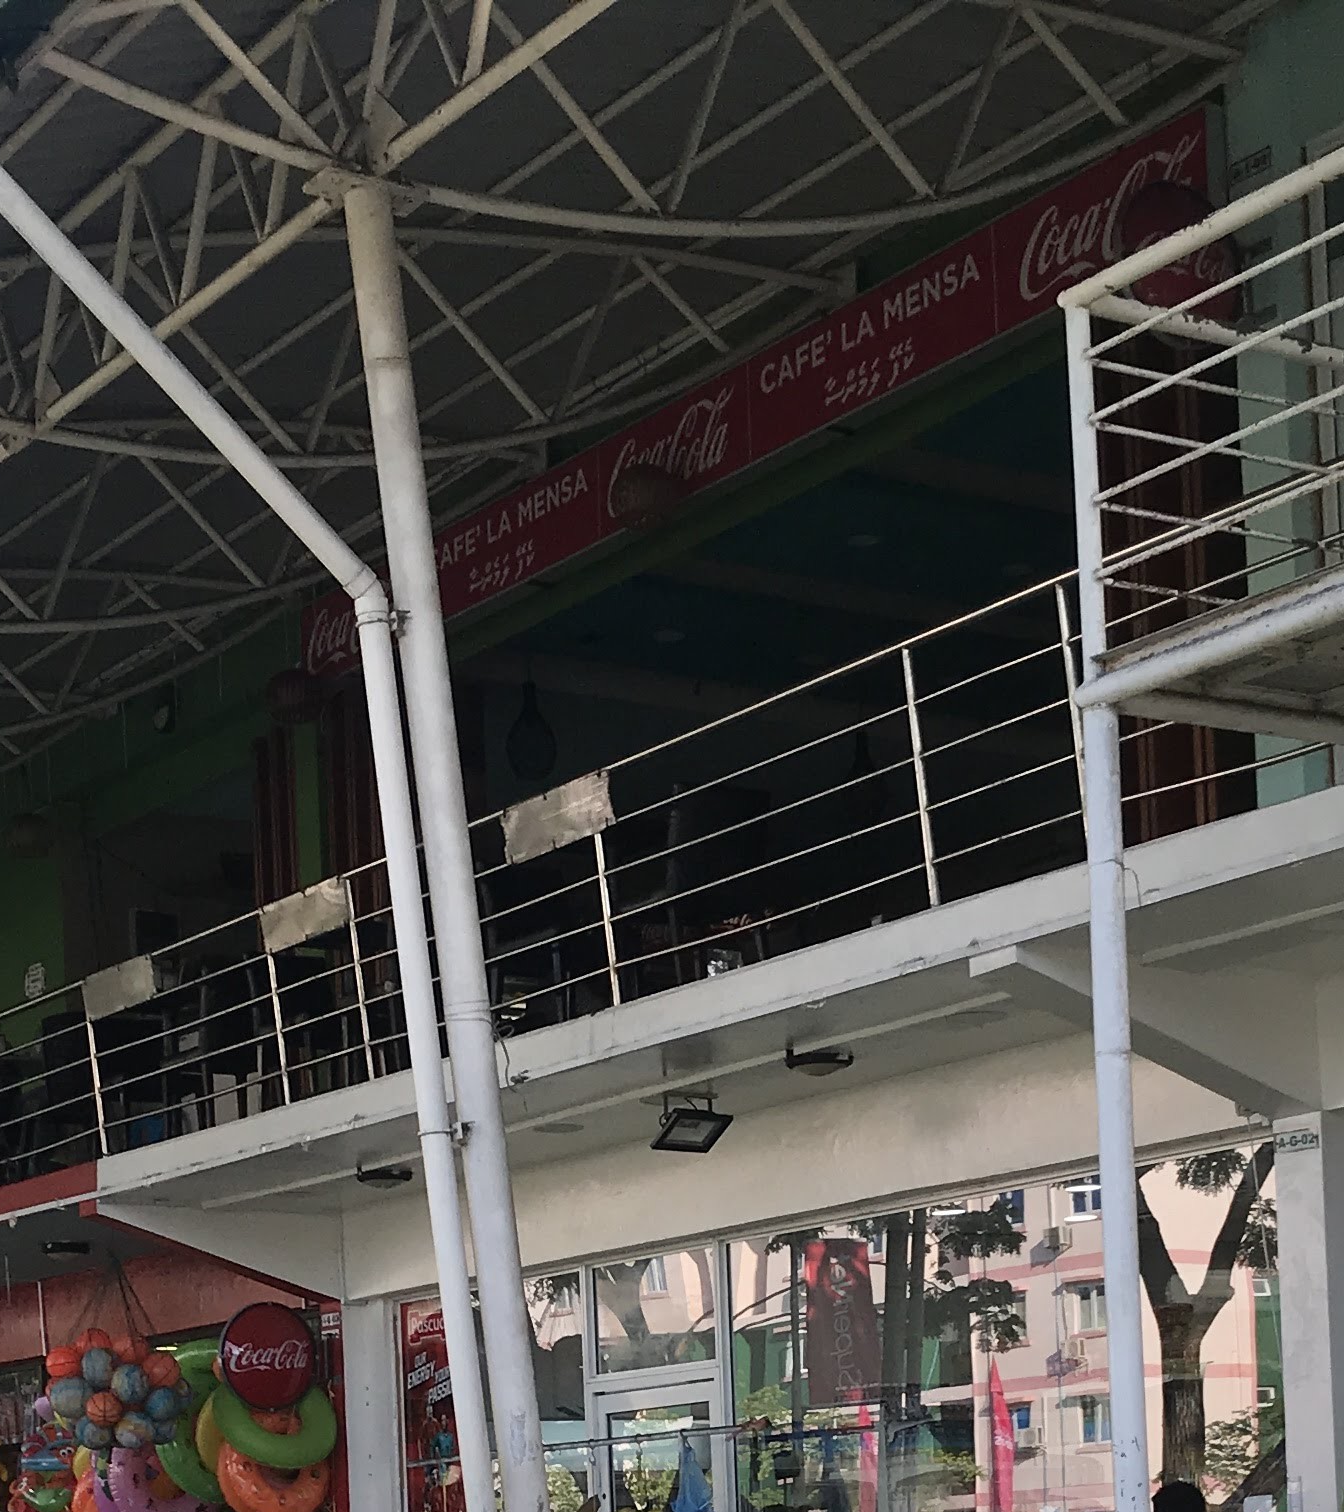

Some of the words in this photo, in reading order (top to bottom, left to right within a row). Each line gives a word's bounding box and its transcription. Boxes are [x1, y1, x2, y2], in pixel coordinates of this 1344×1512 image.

[840, 310, 876, 352] LA
[882, 252, 980, 330] MENSA
[437, 524, 482, 571] AFE'
[486, 510, 514, 544] LA
[516, 468, 589, 529] MENSA
